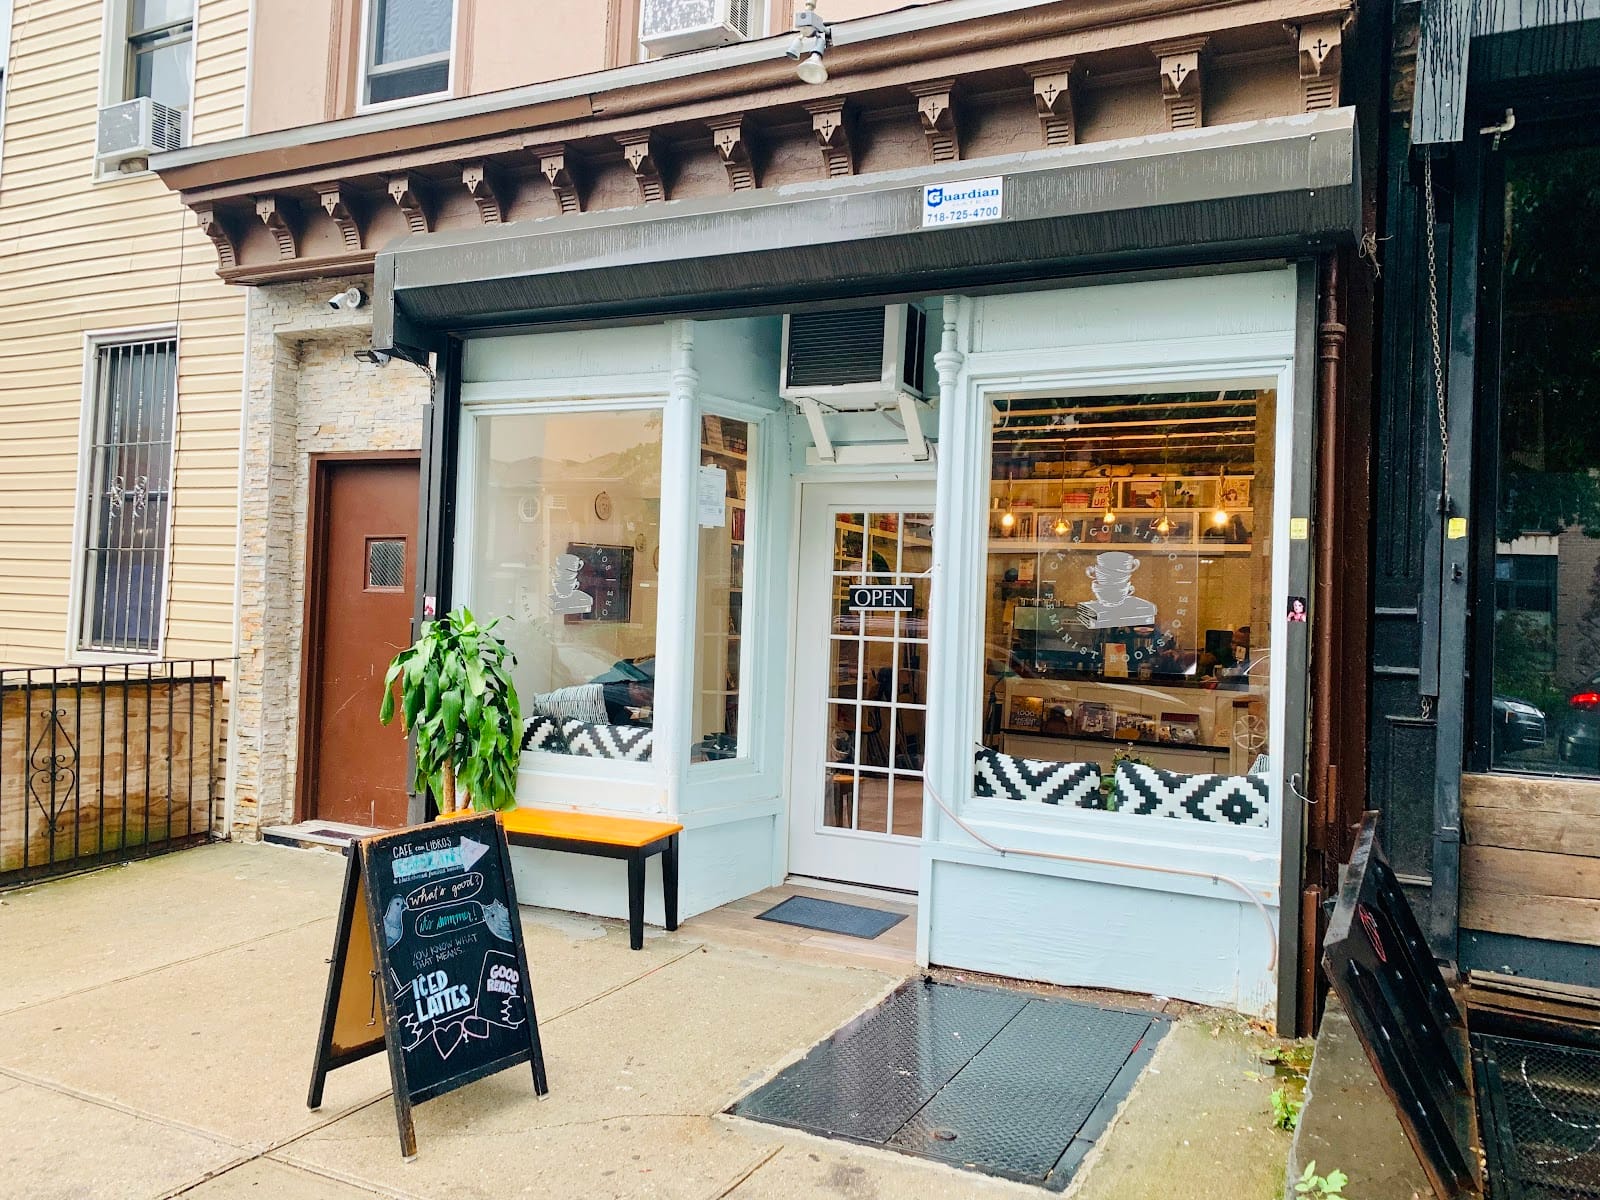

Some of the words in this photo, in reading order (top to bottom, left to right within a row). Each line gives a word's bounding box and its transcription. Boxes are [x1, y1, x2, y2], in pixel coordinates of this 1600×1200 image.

[927, 187, 999, 207] Guardian
[928, 206, 998, 223] 718-725-4700
[1089, 523, 1123, 537] CON
[854, 589, 907, 607] OPEN
[1044, 592, 1099, 660] FEMINIST
[1109, 596, 1189, 663] BOOKSTORE
[392, 843, 413, 859] CAFE
[425, 837, 452, 851] LIBROS
[409, 885, 446, 906] what's
[451, 875, 480, 898] good?
[430, 940, 453, 956] KNOW
[455, 933, 478, 946] WHAT
[490, 964, 520, 983] GOOD
[411, 970, 448, 1000] ICED
[486, 978, 518, 996] READS
[416, 984, 470, 1023] LATTES
